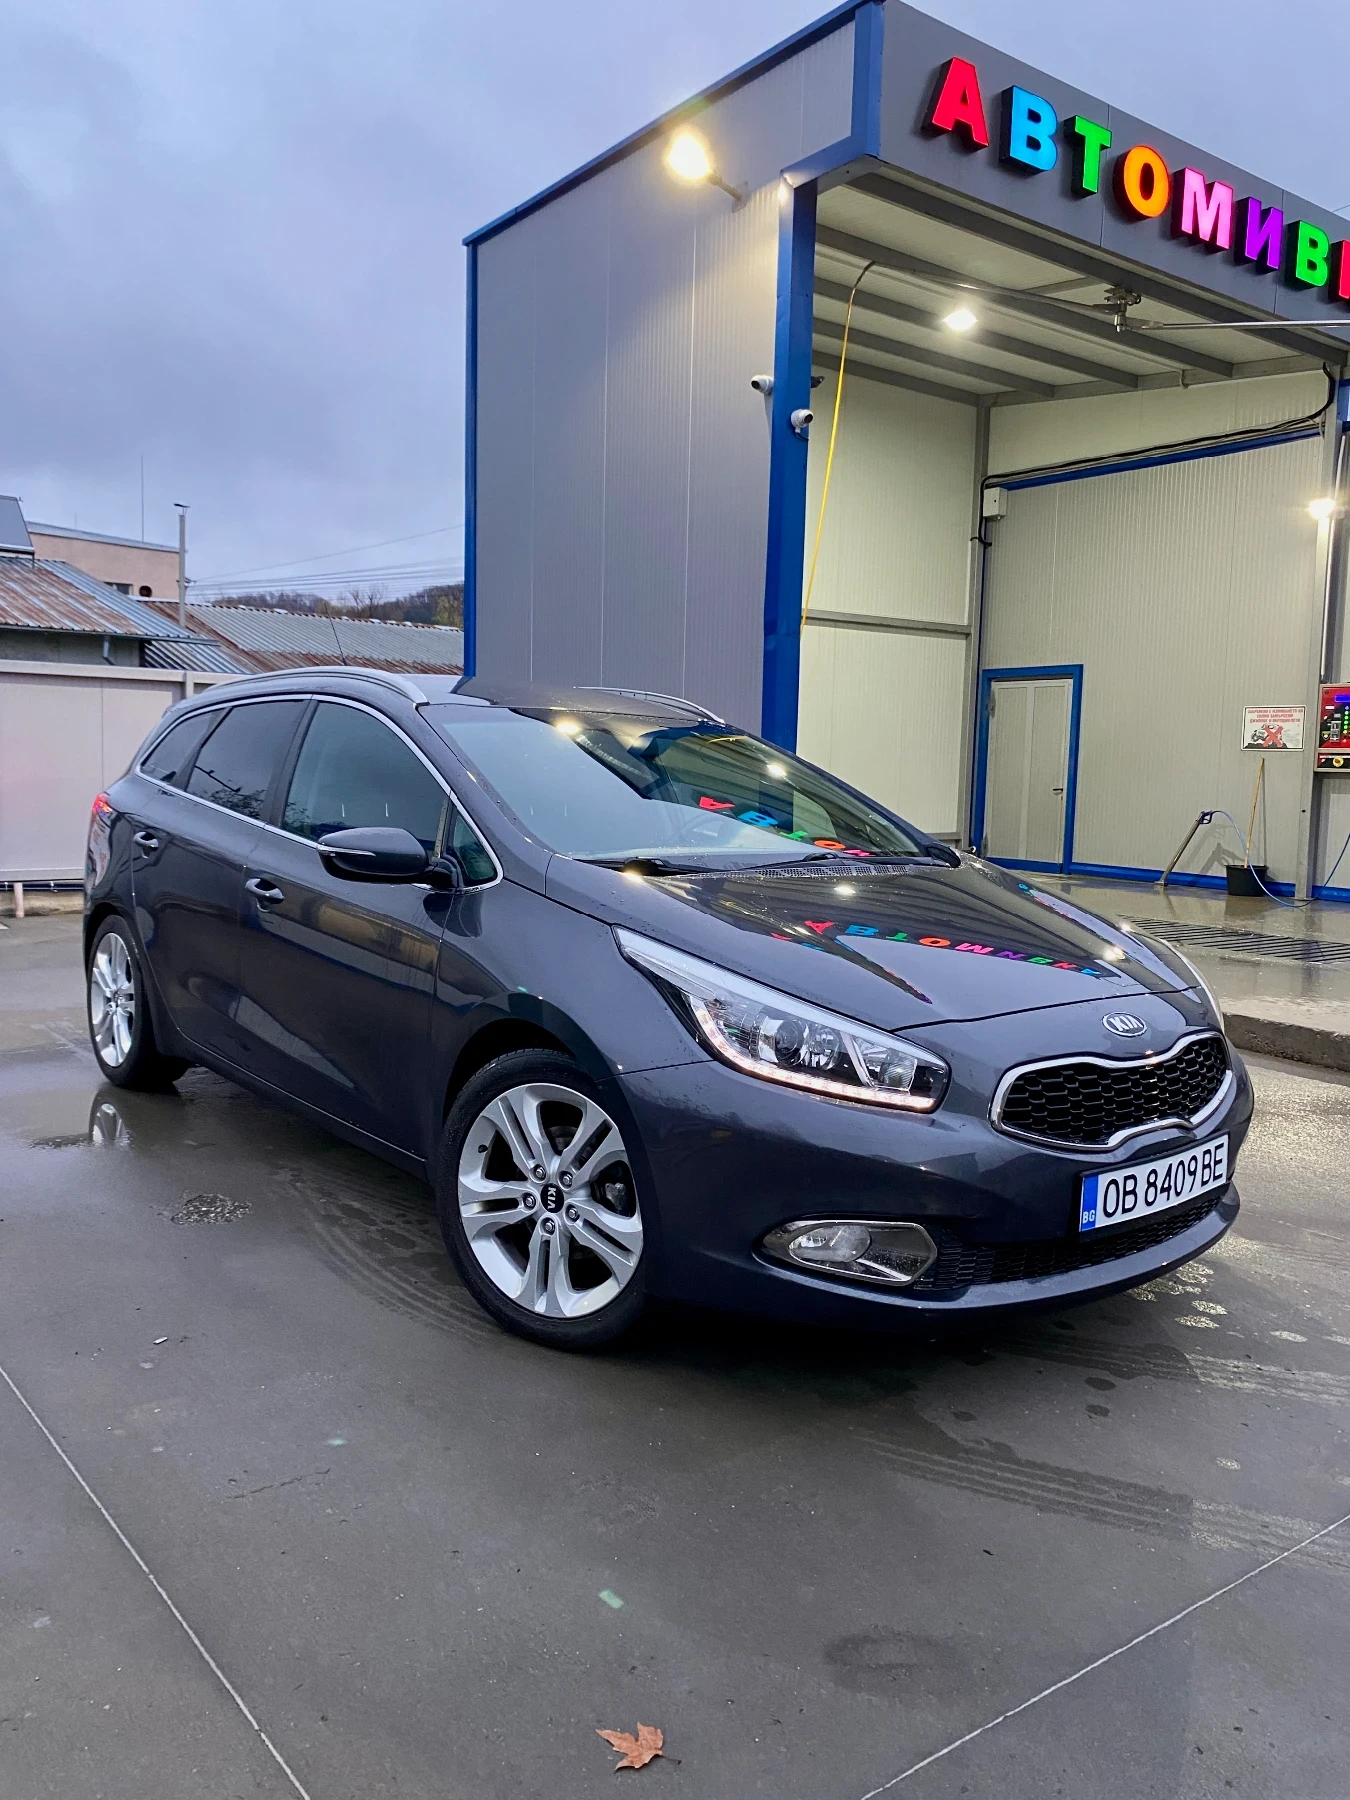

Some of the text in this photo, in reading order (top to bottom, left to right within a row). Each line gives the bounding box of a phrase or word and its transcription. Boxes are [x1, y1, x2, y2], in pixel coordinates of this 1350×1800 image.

[1107, 1015, 1143, 1031] KIA
[1103, 1142, 1225, 1218] OB 8409 BE
[547, 1186, 557, 1210] KIA
[1082, 1210, 1096, 1224] BG
